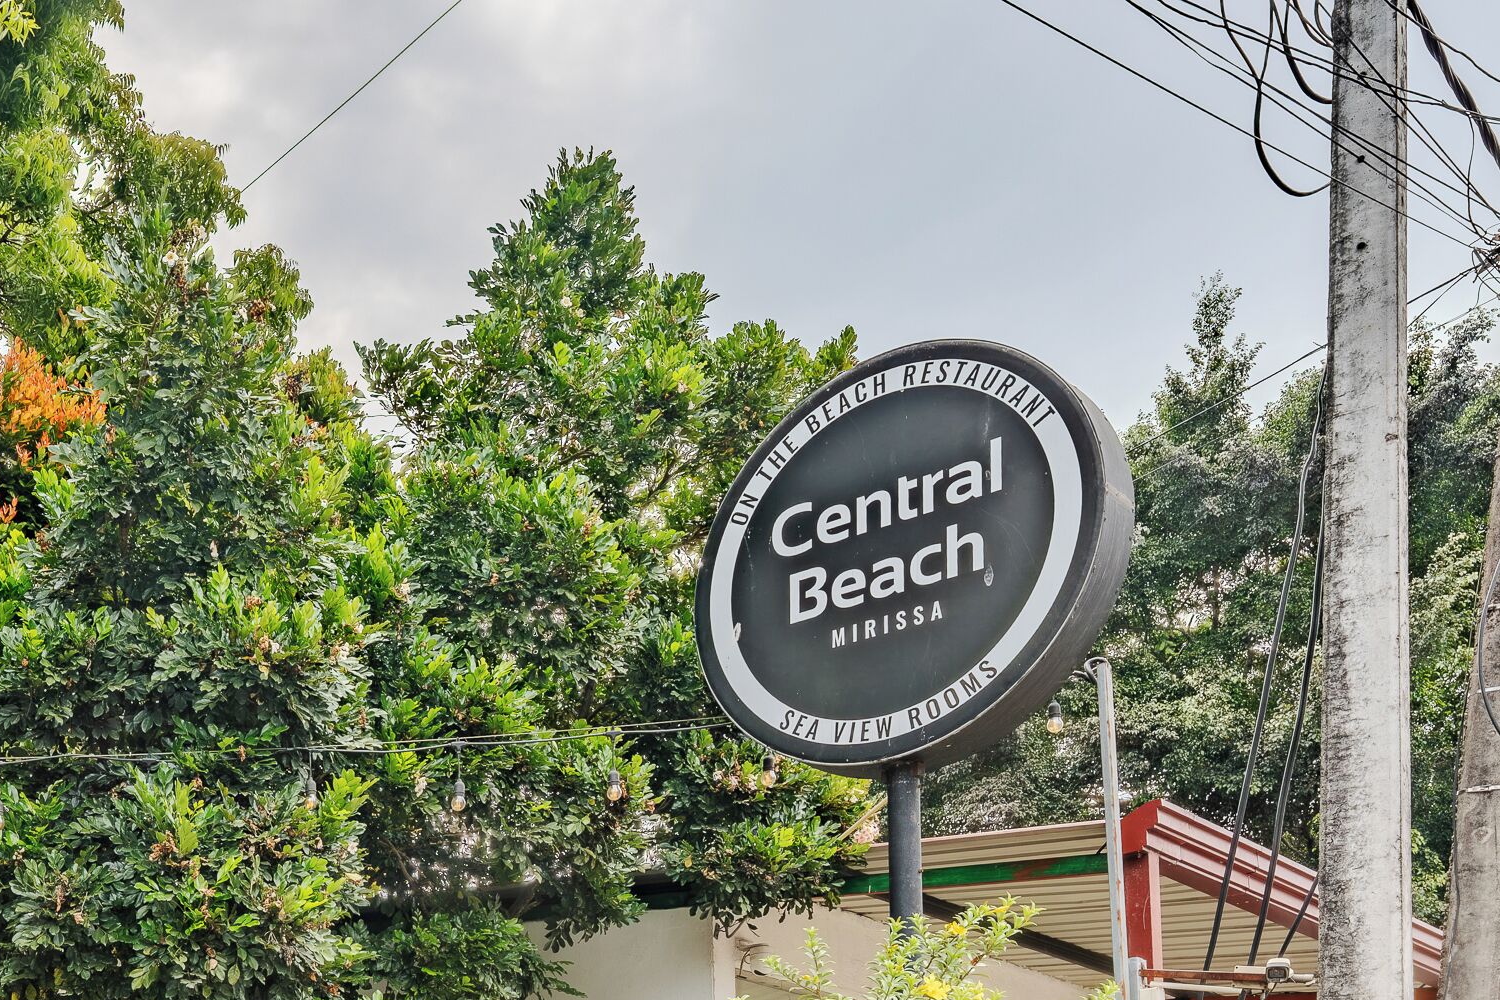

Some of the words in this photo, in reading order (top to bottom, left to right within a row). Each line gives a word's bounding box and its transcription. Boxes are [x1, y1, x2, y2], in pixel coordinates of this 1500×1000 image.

[731, 494, 759, 526] ON
[755, 435, 800, 481] THE
[804, 372, 887, 435] BEACH
[903, 360, 1057, 429] RESTAURANT
[771, 436, 1003, 558] Central
[789, 523, 985, 625] Beach
[831, 600, 943, 648] MIRISSA
[779, 709, 820, 740] SEA
[834, 716, 893, 743] VIEW
[908, 660, 998, 729] ROOMS
